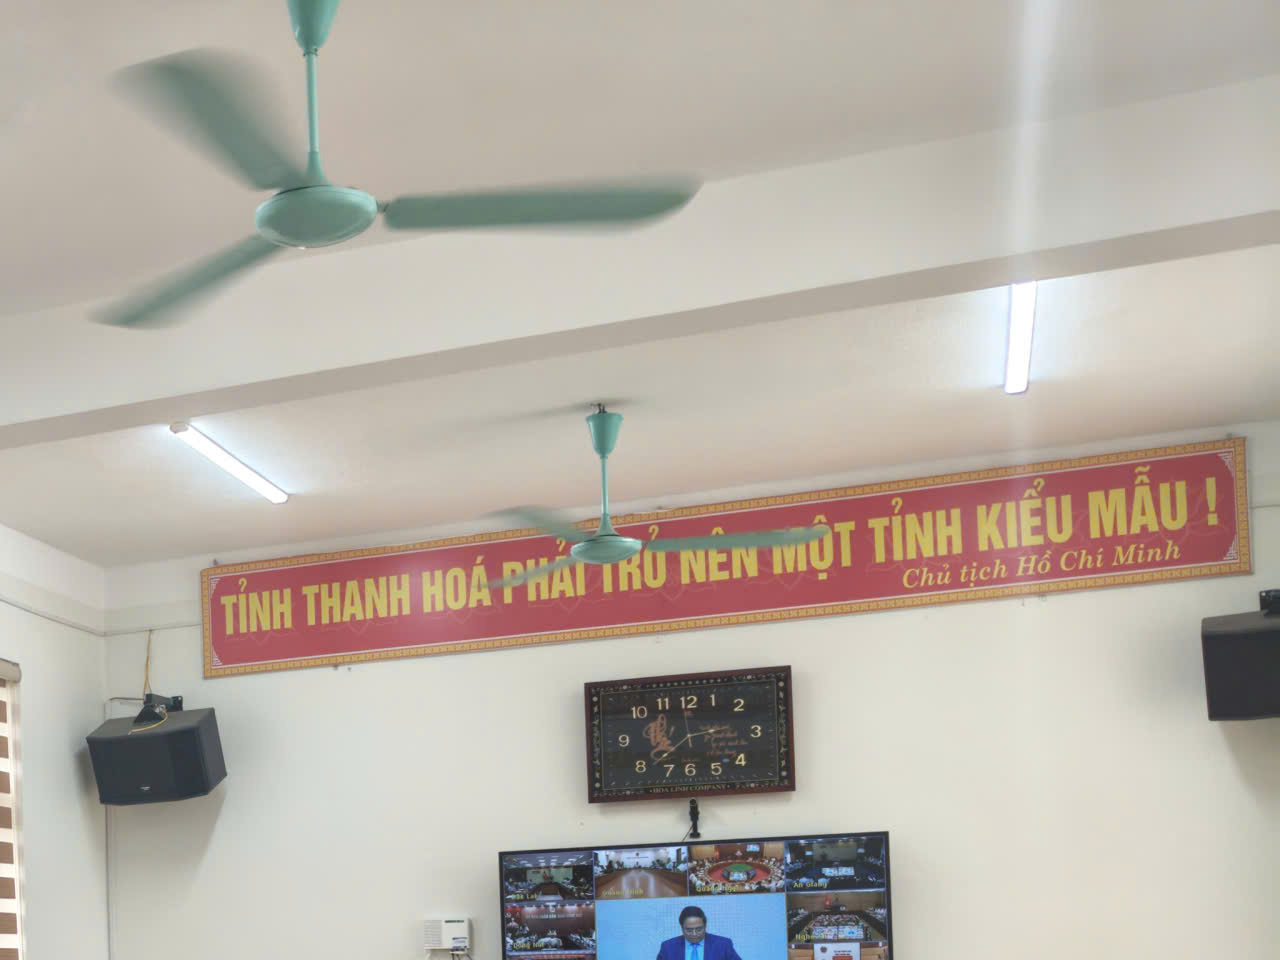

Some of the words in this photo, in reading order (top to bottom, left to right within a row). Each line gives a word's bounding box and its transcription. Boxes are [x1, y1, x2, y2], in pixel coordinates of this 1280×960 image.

[221, 578, 292, 635] TỈNH
[302, 574, 410, 626] THANH
[422, 555, 492, 613] HOÁ
[503, 537, 585, 604] PHẢI
[680, 527, 758, 584] NÊN
[772, 514, 855, 580] MỘT
[868, 497, 963, 563] TỈNH
[977, 478, 1072, 552] KIỂU
[1088, 465, 1187, 539] MẪU
[902, 563, 951, 588] Chủ
[960, 559, 1008, 587] tịch
[1016, 550, 1052, 577] Hồ
[1060, 548, 1104, 571] Chí
[1112, 540, 1181, 566] Minh
[657, 698, 669, 710] 11
[680, 695, 698, 709] 12
[710, 694, 716, 707] 1
[733, 699, 745, 712] 2
[631, 706, 648, 719] 10
[750, 725, 762, 738] 3
[618, 734, 630, 747] 9
[635, 760, 647, 773] 8
[735, 753, 747, 767] 4
[663, 764, 675, 777] 7
[684, 764, 696, 776] 6
[711, 762, 722, 775] 5
